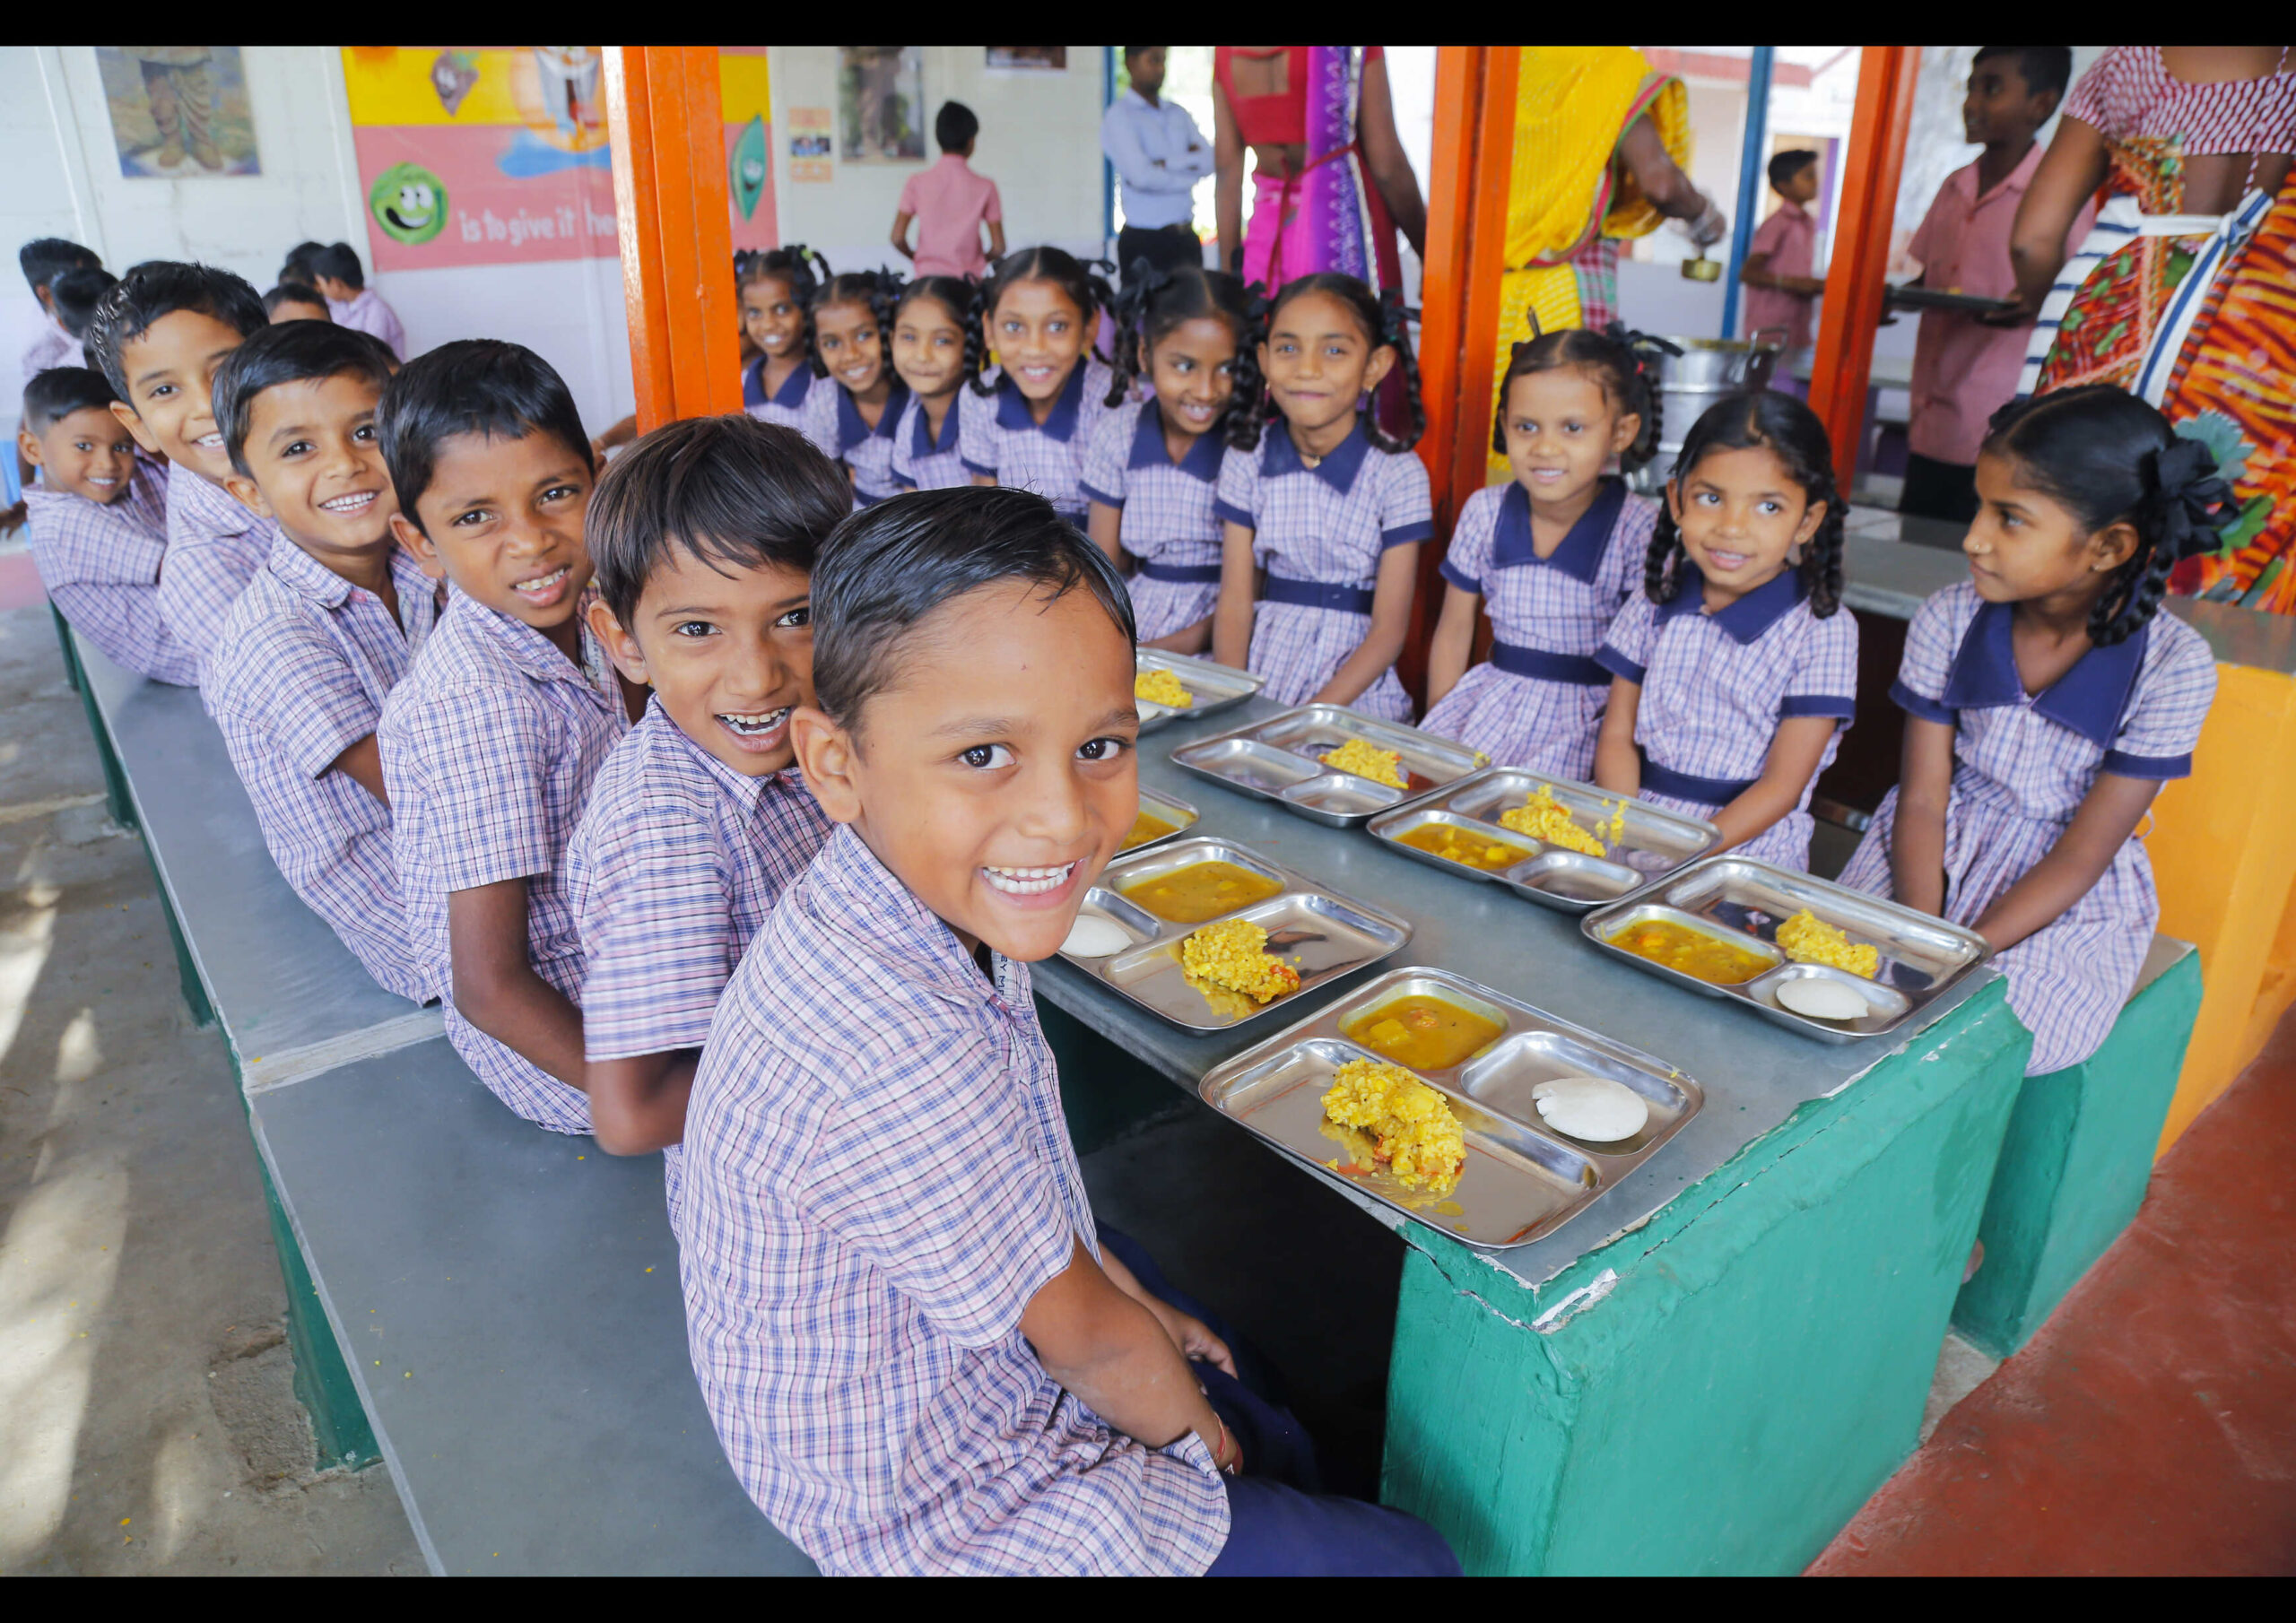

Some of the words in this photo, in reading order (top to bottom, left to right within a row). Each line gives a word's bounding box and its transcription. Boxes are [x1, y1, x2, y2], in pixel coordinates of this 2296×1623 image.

[458, 209, 482, 242] is
[483, 208, 507, 241] to
[509, 207, 555, 247] give
[555, 205, 574, 239] it
